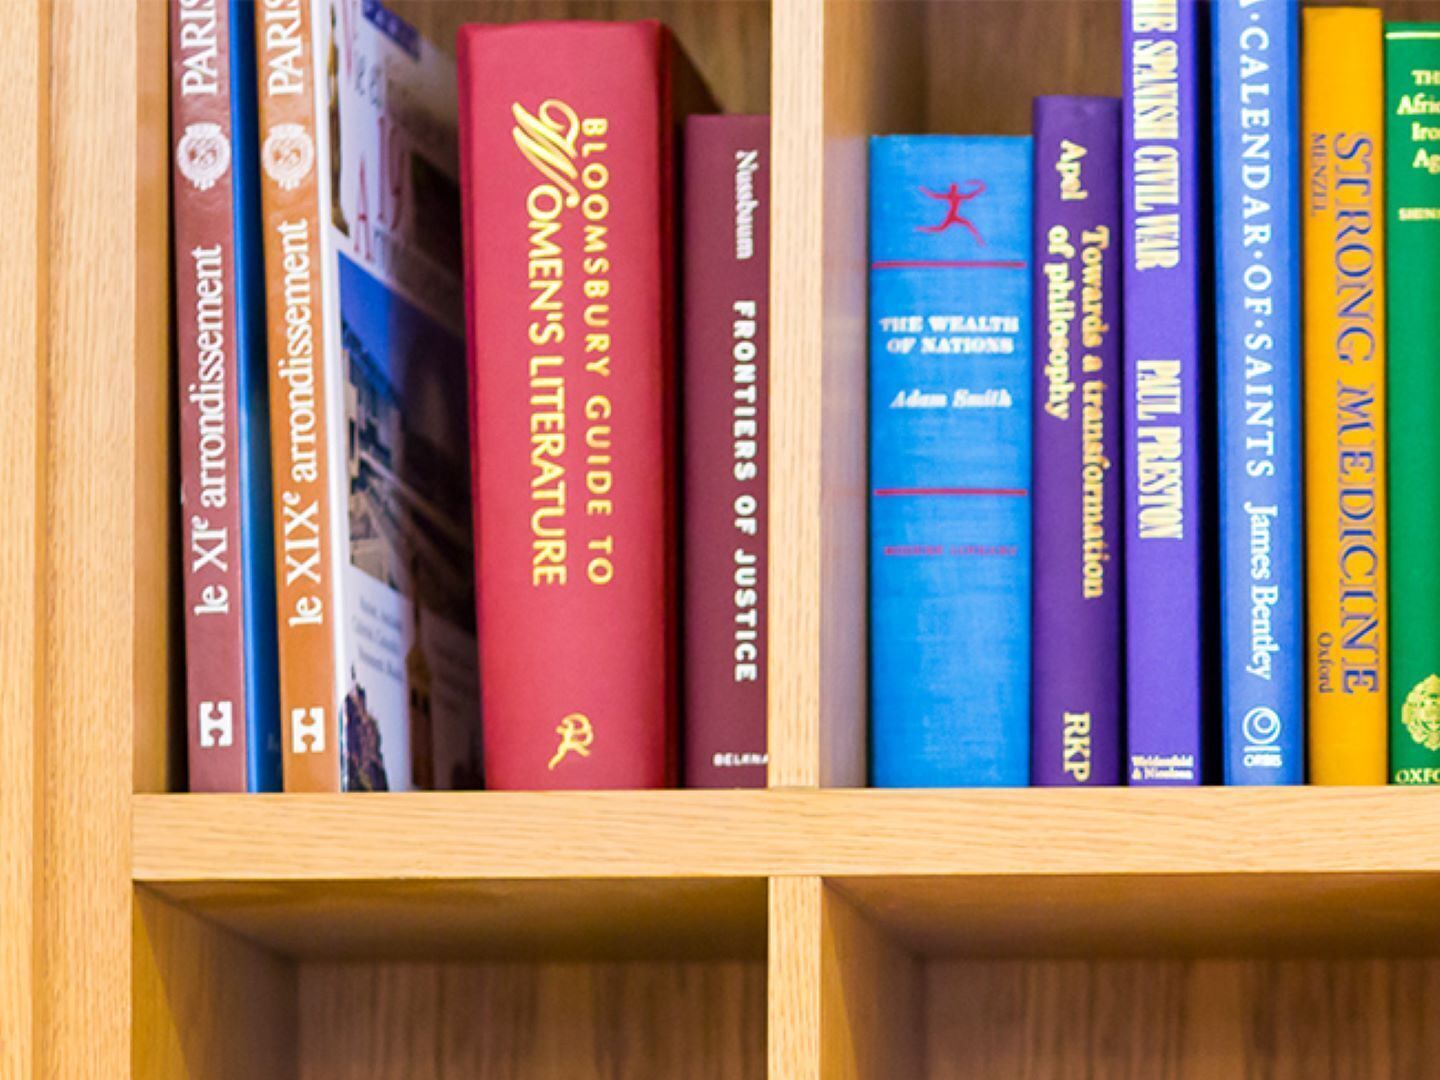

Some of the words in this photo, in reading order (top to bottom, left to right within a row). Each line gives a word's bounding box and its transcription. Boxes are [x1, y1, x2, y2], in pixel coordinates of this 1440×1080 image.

[180, 0, 220, 96] PARIS
[266, 0, 304, 96] PARIS
[1133, 39, 1179, 139] SPANISH
[1055, 140, 1088, 200] Apel
[1134, 146, 1179, 212] CIVIL
[1240, 28, 1271, 247] CALENDAR
[1310, 133, 1327, 217] MENZEL
[512, 98, 580, 345] WOMEN'S
[582, 118, 611, 376] BLOOMSBURY
[735, 150, 759, 260] Nussbaum
[1048, 225, 1075, 259] of
[1135, 214, 1180, 271] WAR
[1333, 132, 1376, 364] STRONG
[879, 316, 922, 332] THE
[928, 316, 1019, 333] WEALTH
[1081, 225, 1110, 347] Towards
[189, 245, 227, 508] arrondissement
[277, 218, 318, 483] arrondissement
[886, 337, 916, 353] OF
[920, 337, 1014, 353] NATIONS
[1043, 262, 1076, 420] philosophy
[1082, 354, 1103, 372] a
[733, 301, 757, 481] FRONTIERS
[889, 390, 948, 409] Adam
[952, 389, 1012, 408] Smith
[1136, 360, 1182, 421] PAUL
[1244, 333, 1274, 477] SAINTS
[529, 356, 568, 586] LITERATURE
[585, 396, 612, 516] GUIDE
[1082, 381, 1110, 598] transformation
[1137, 426, 1184, 538] PRESTON
[587, 535, 614, 585] TO
[734, 496, 758, 536] OF
[1244, 502, 1278, 579] James
[1336, 379, 1379, 693] MEDICINE
[194, 584, 229, 616] le
[289, 595, 323, 627] le
[734, 549, 759, 682] JUSTICE
[1246, 585, 1280, 679] Bentley
[1317, 632, 1334, 693] Oxford
[1062, 712, 1091, 782] RKP
